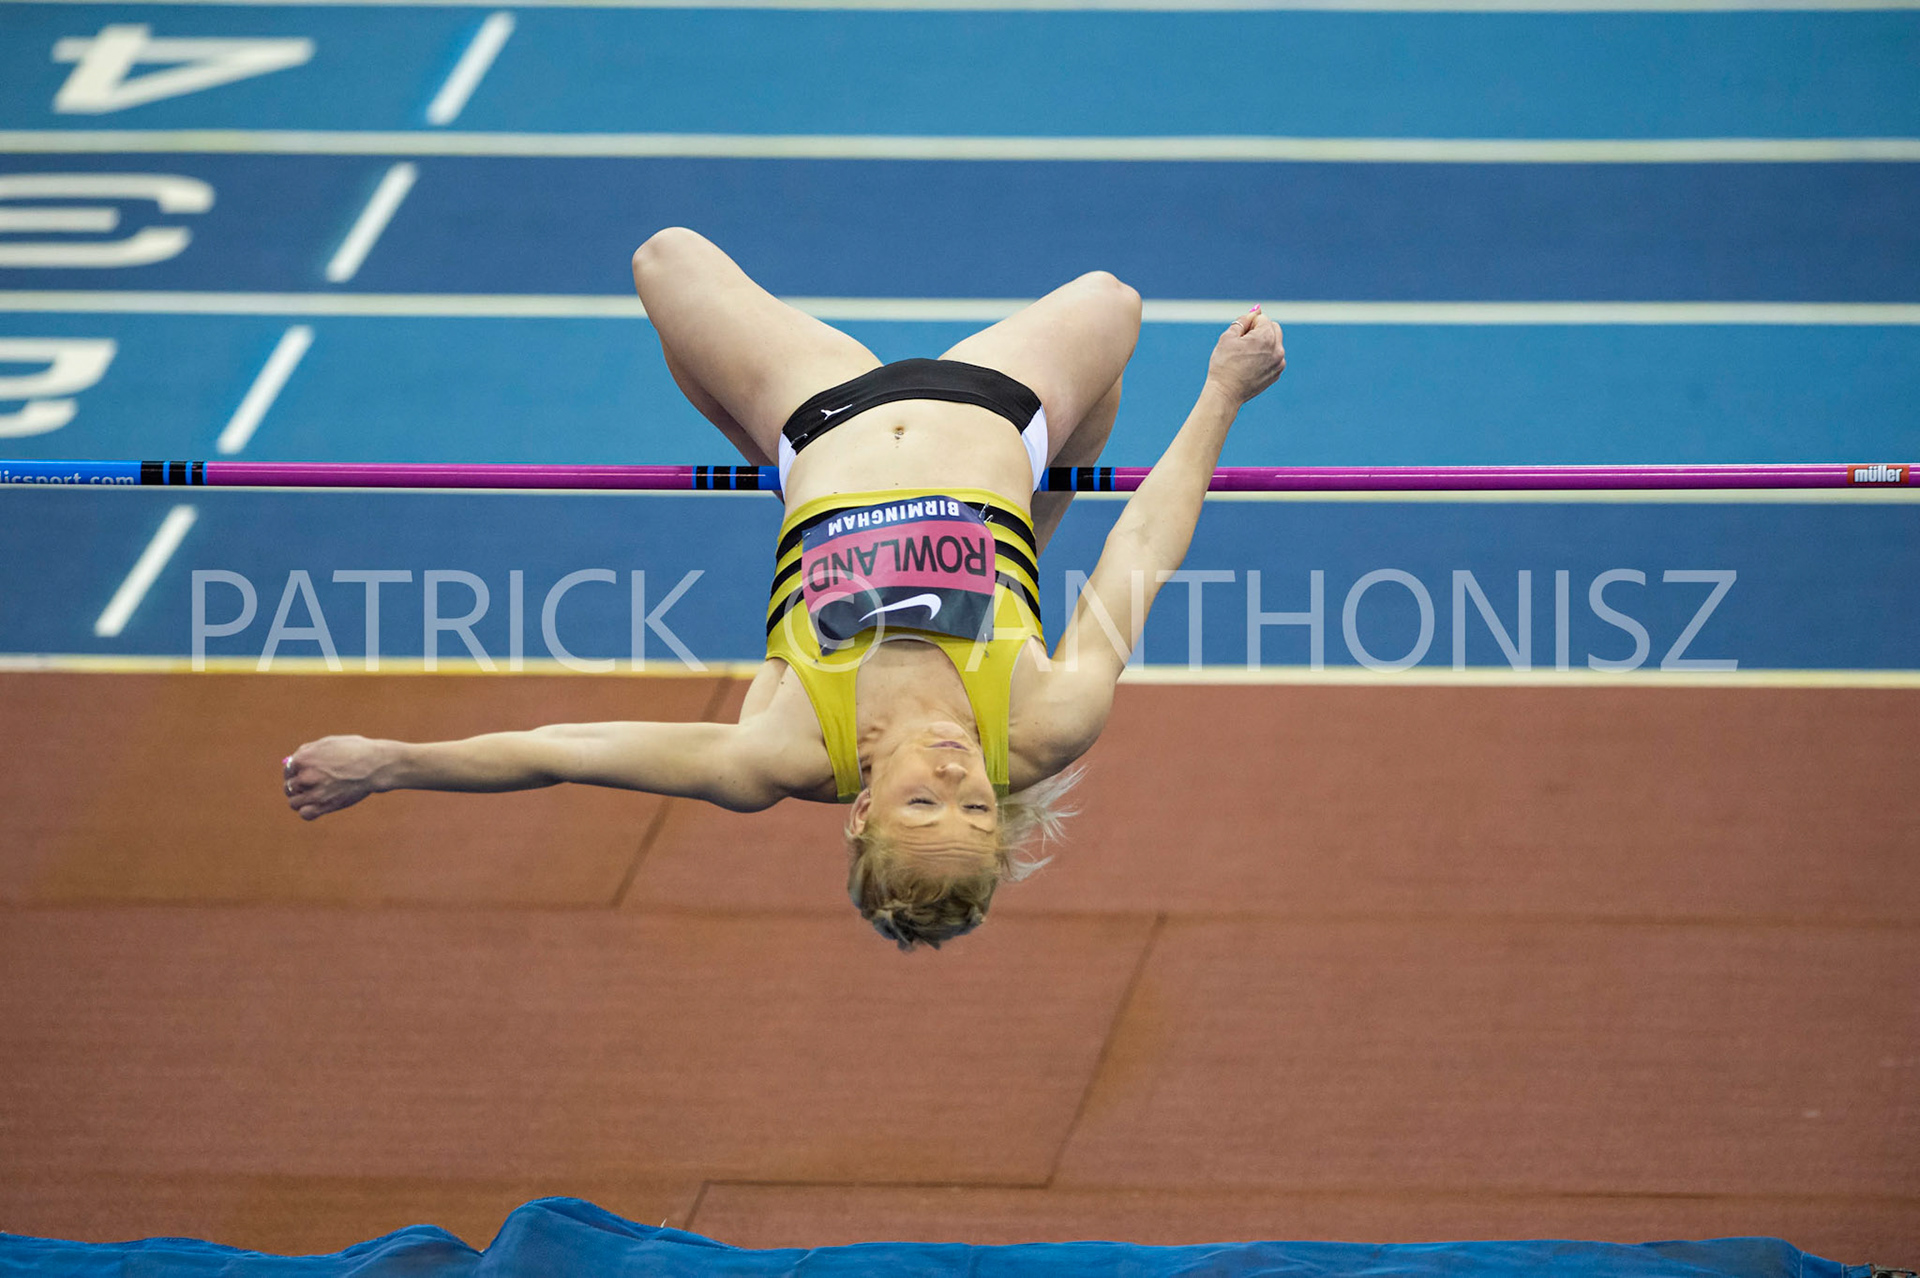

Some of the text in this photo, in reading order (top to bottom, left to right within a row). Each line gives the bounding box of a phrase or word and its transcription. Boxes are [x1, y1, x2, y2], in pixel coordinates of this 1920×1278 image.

[52, 23, 315, 114] 4
[1854, 465, 1903, 483] müller
[828, 499, 960, 536] BIRMINGHAM
[807, 535, 987, 593] ROWLAND
